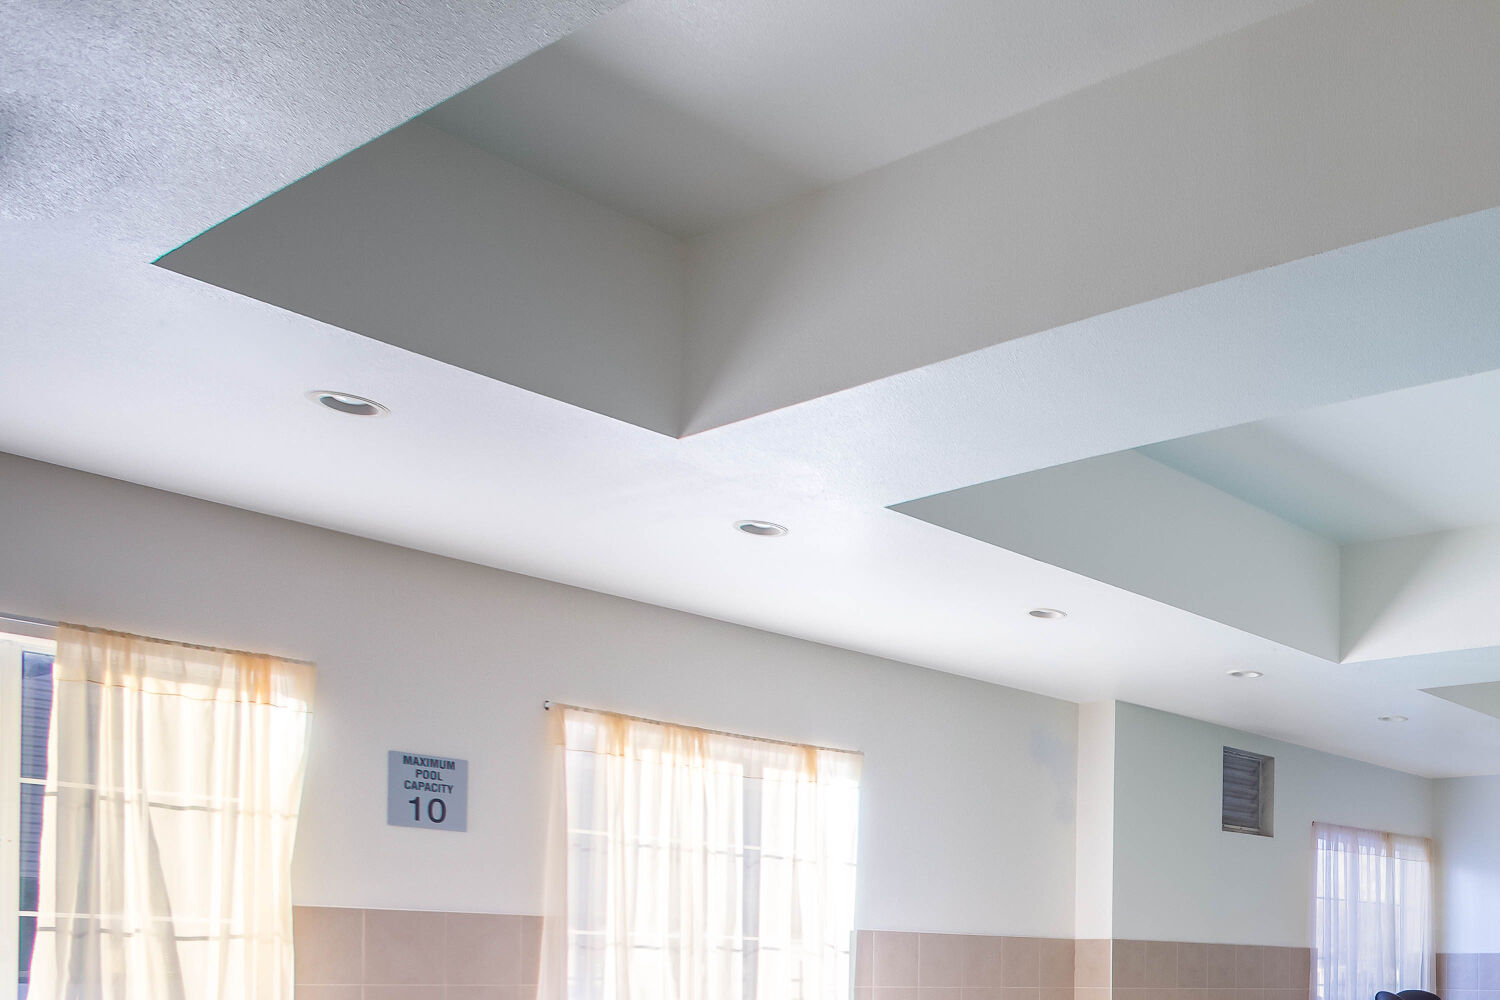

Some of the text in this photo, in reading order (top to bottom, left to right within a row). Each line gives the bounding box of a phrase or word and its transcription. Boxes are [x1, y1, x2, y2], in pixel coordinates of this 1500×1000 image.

[402, 755, 456, 770] MAXIMUM
[415, 769, 443, 781] POOL
[404, 780, 454, 794] CAPACITY
[408, 796, 447, 823] 10
